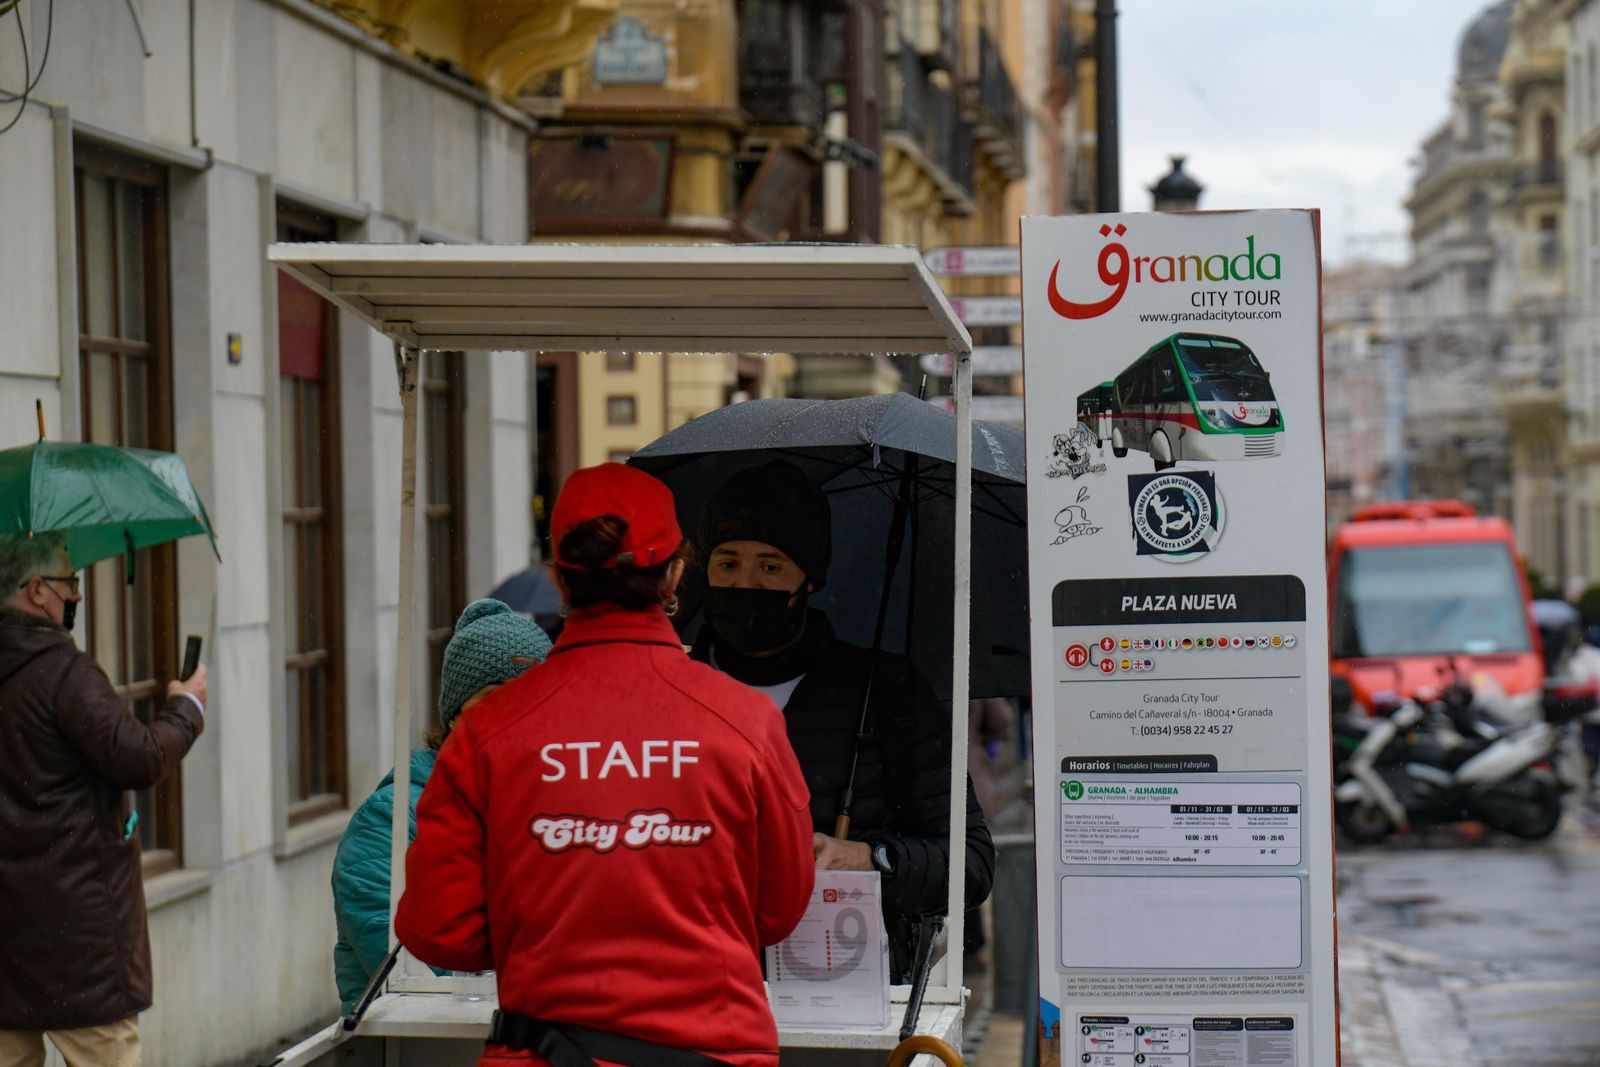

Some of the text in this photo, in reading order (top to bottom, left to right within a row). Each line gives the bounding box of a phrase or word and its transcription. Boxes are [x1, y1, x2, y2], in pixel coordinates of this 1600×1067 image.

[1191, 290, 1280, 307] CITY TOUR
[1139, 309, 1282, 324] www.granadacitytour.com
[1190, 486, 1208, 512] PERSONAL
[1121, 594, 1237, 612] PLAZA NUEVA
[1143, 693, 1219, 704] Granada City Tour
[1090, 710, 1122, 720] Camino
[1123, 710, 1137, 719] del
[1138, 709, 1182, 719] Cañaveral
[1203, 709, 1230, 718] 18004
[1237, 708, 1273, 717] Granada
[1140, 725, 1172, 737] (0034)
[1174, 726, 1192, 735] 958
[1193, 726, 1206, 735] 22
[1207, 725, 1220, 734] 45
[1222, 725, 1233, 734] 27
[540, 740, 700, 782] STAFF
[1069, 760, 1110, 770] Horarios
[1153, 761, 1179, 769] Horaires
[1183, 761, 1210, 770] Fahrplan
[1087, 787, 1178, 795] GRANADA ALHAMBRA
[532, 813, 712, 849] City Tour
